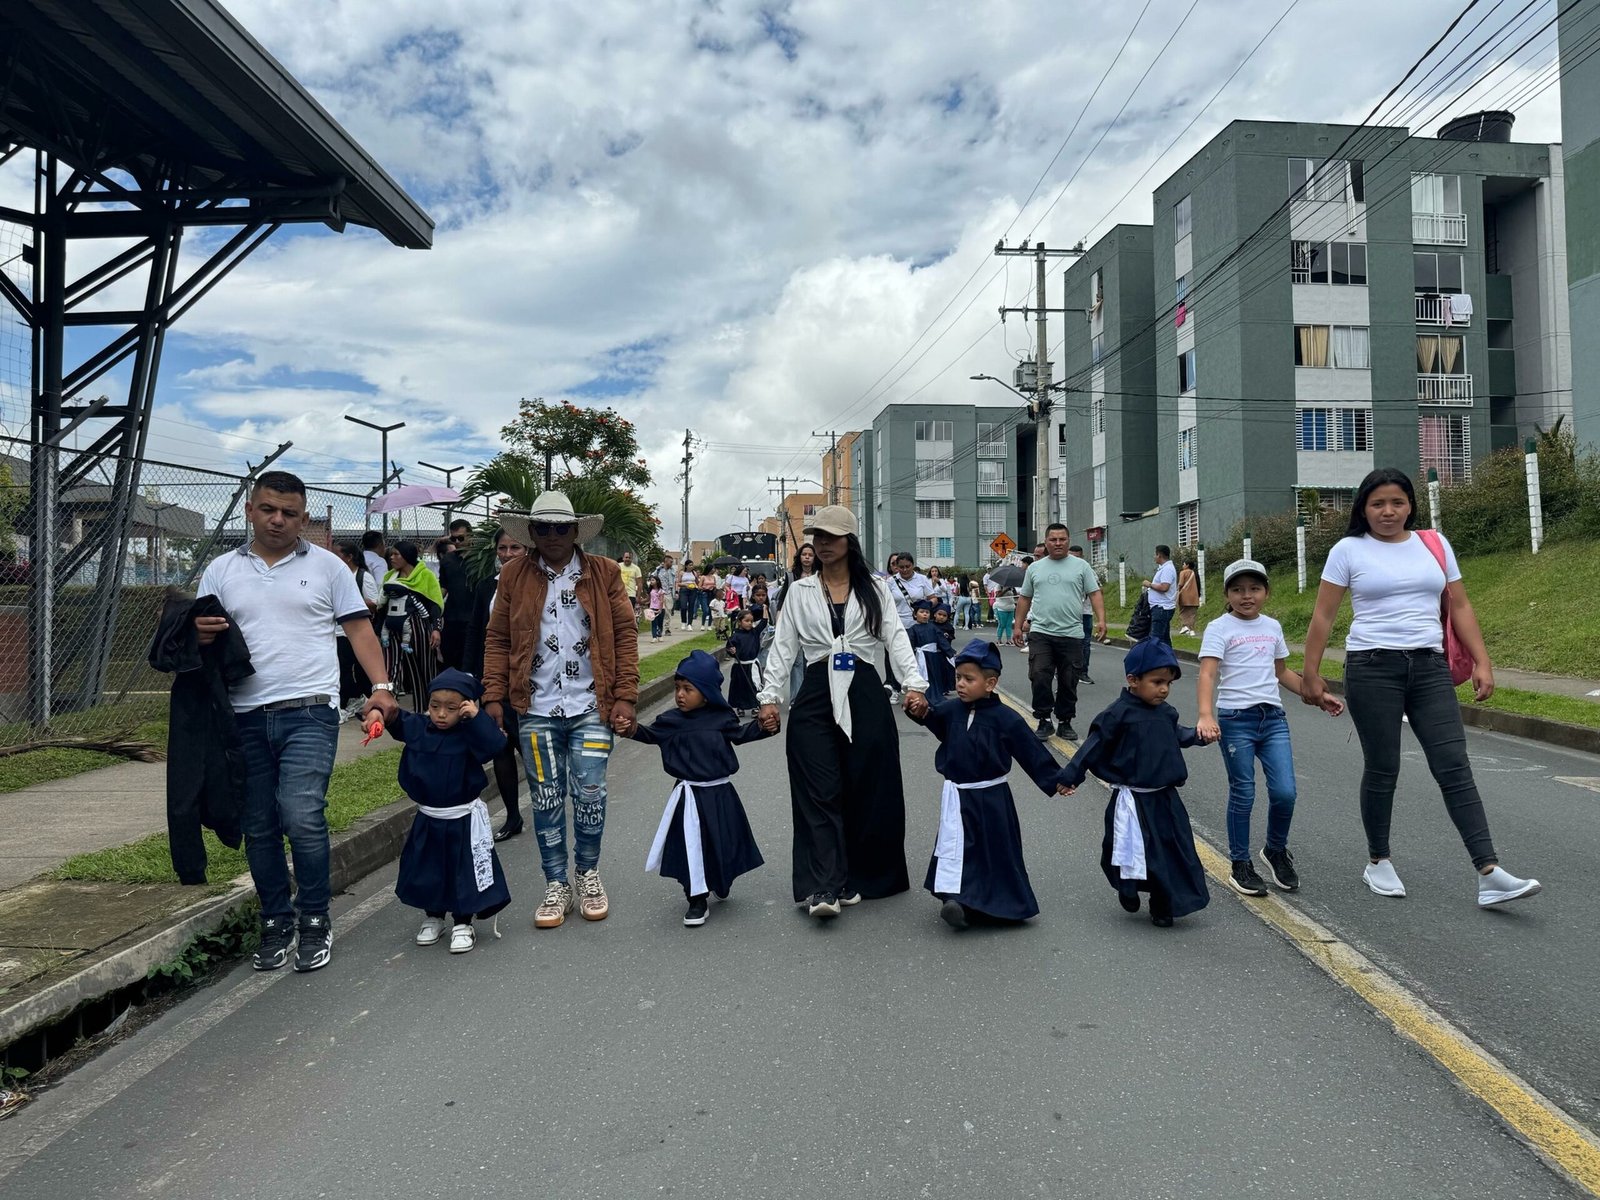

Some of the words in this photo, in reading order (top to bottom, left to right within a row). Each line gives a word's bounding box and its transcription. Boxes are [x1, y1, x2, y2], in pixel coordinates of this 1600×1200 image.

[561, 591, 577, 604] 62
[565, 661, 579, 676] 62
[577, 810, 603, 825] BACK
